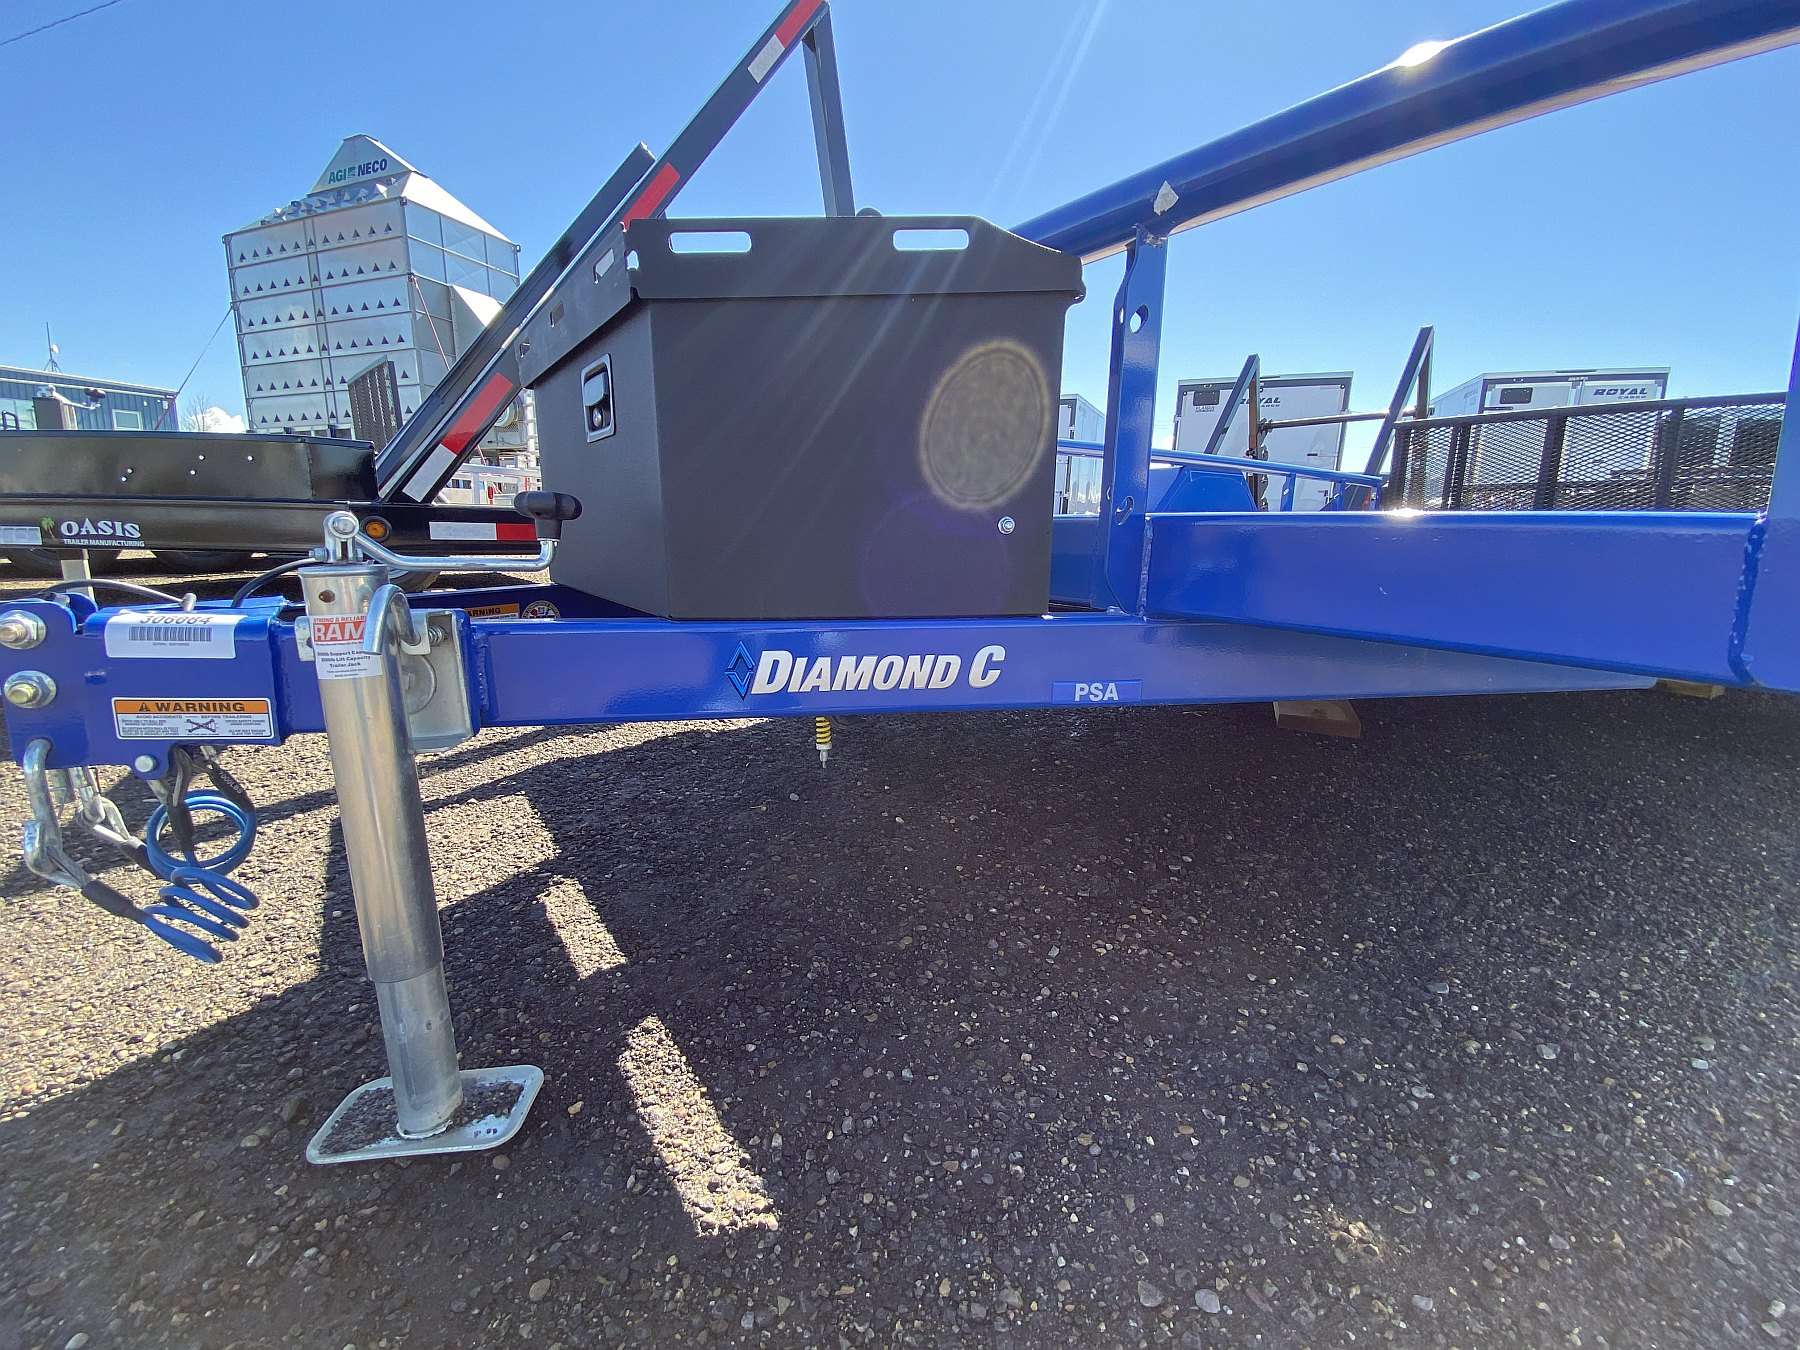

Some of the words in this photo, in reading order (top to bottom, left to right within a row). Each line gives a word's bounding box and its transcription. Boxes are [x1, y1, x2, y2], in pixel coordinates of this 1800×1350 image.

[328, 169, 347, 184] AGI
[357, 158, 388, 177] NECO
[1593, 387, 1648, 396] ROYAL
[60, 518, 142, 539] OASIS
[63, 538, 89, 546] TRAILER
[89, 539, 145, 547] MANUFACTURING
[314, 622, 365, 641] RAM
[751, 650, 962, 695] DIAMOND
[968, 644, 1006, 689] C
[1074, 682, 1119, 702] PSA
[155, 702, 246, 713] WARNING
